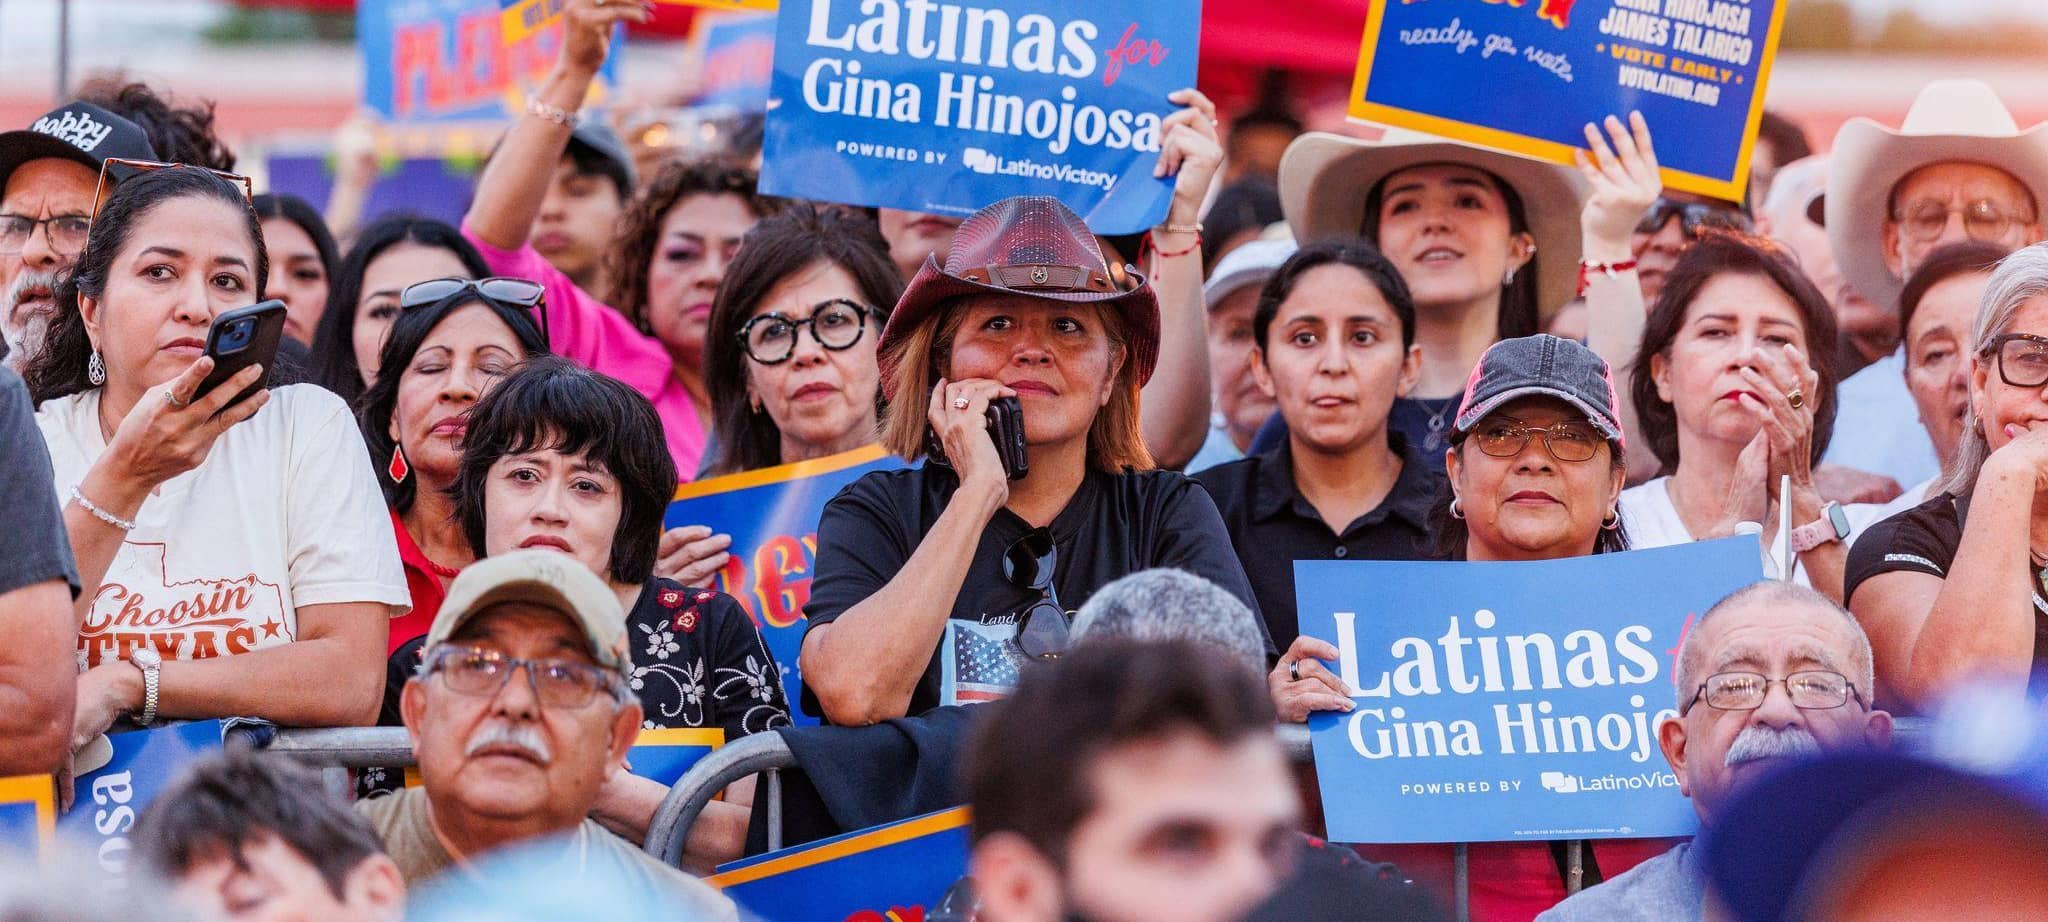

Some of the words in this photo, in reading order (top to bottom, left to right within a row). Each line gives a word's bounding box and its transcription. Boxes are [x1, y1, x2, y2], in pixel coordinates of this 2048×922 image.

[1599, 7, 1671, 46] JAMES
[1673, 21, 1753, 66] TALARICO
[1664, 0, 1751, 36] HINOJOSA
[806, 0, 1098, 79] Latinas
[1104, 22, 1170, 87] for
[1611, 44, 1666, 69] VOTE
[1671, 57, 1732, 84] EARLY
[803, 58, 921, 123] Gina
[934, 72, 1162, 155] Hinojosa
[1618, 64, 1720, 107] VOTOLATINO.ORG
[836, 140, 918, 162] POWERED
[924, 150, 948, 165] BY
[997, 155, 1118, 191] LatinoVictory
[80, 573, 257, 635] Choosin'
[980, 612, 1016, 625] Land
[77, 627, 257, 669] TEXAS
[1334, 609, 1659, 698] Latinas
[1348, 706, 1483, 760] Gina
[1401, 781, 1490, 796] POWERED
[1500, 780, 1522, 791] BY
[92, 769, 135, 890] osa
